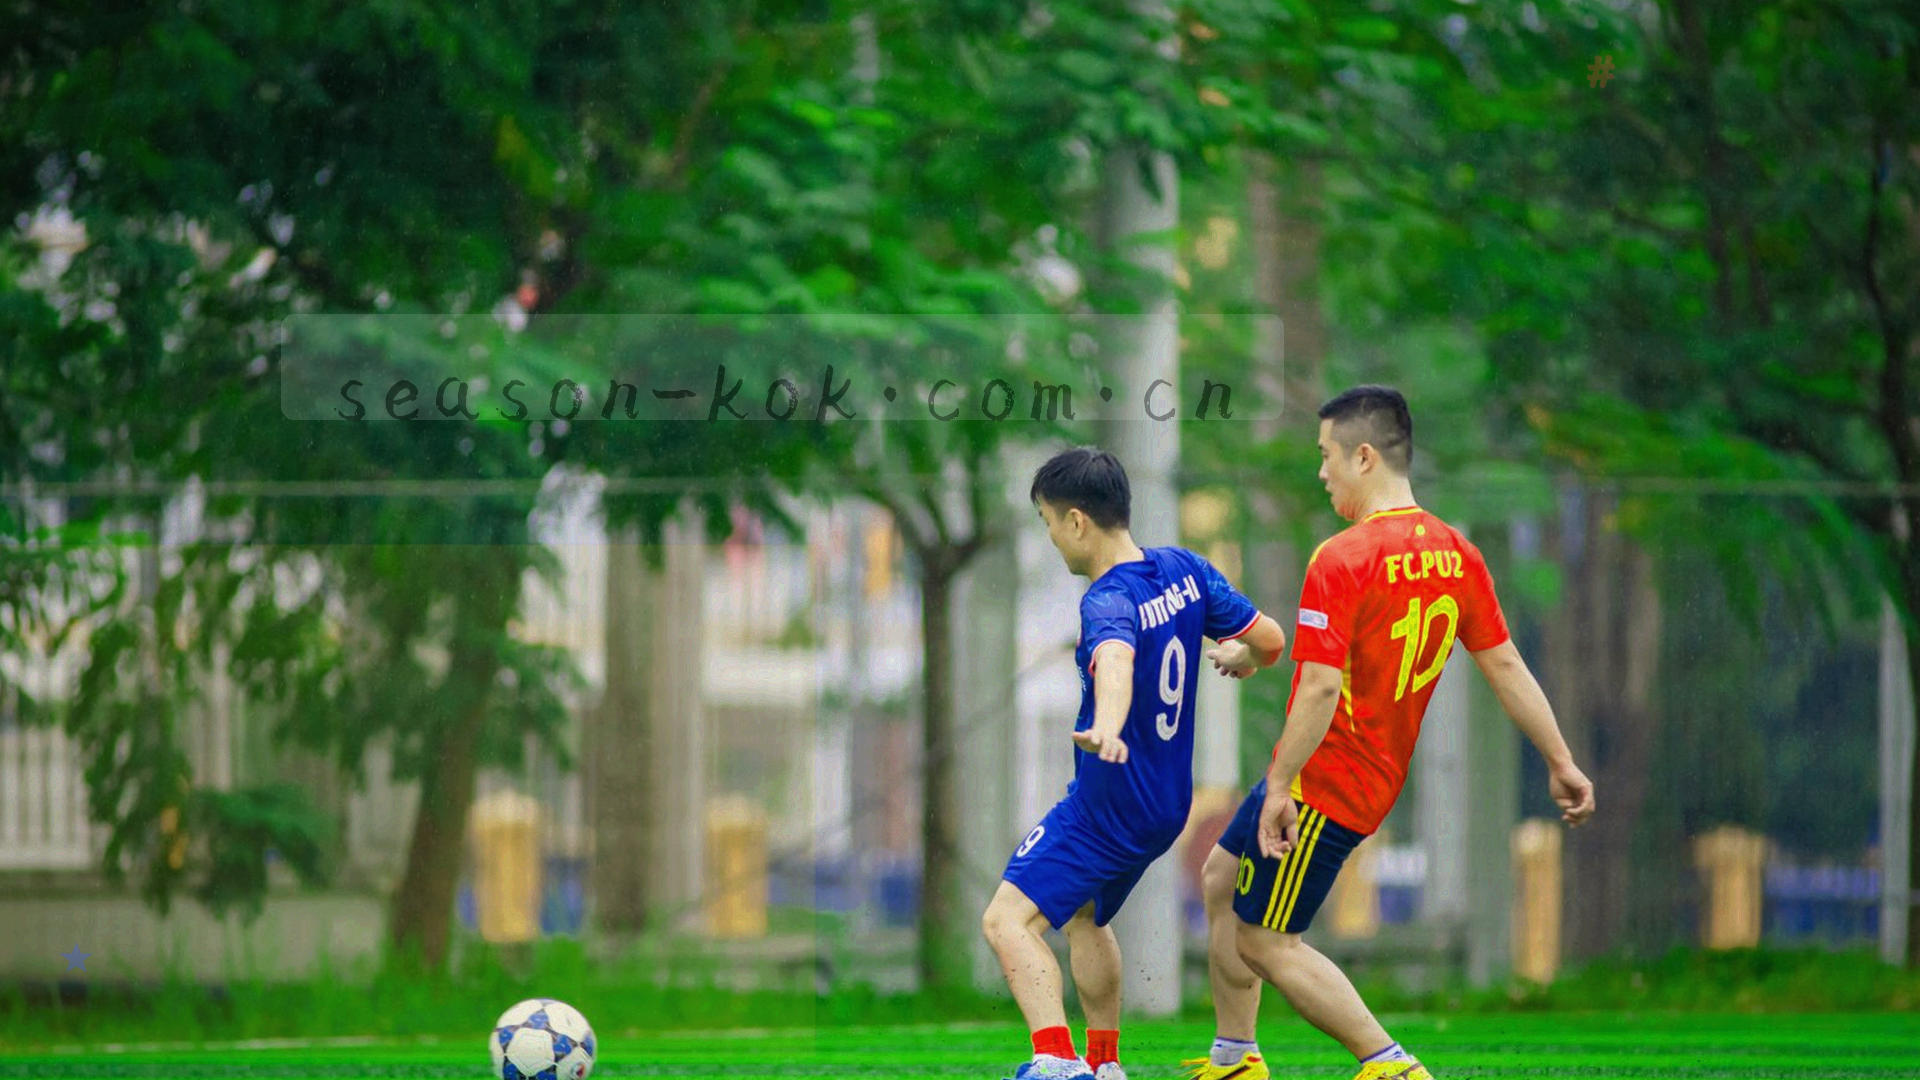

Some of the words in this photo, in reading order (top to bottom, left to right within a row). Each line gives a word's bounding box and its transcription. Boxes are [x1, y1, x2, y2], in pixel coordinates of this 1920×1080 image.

[1156, 635, 1186, 741] 9
[1390, 594, 1460, 702] 10
[1016, 825, 1045, 858] 9
